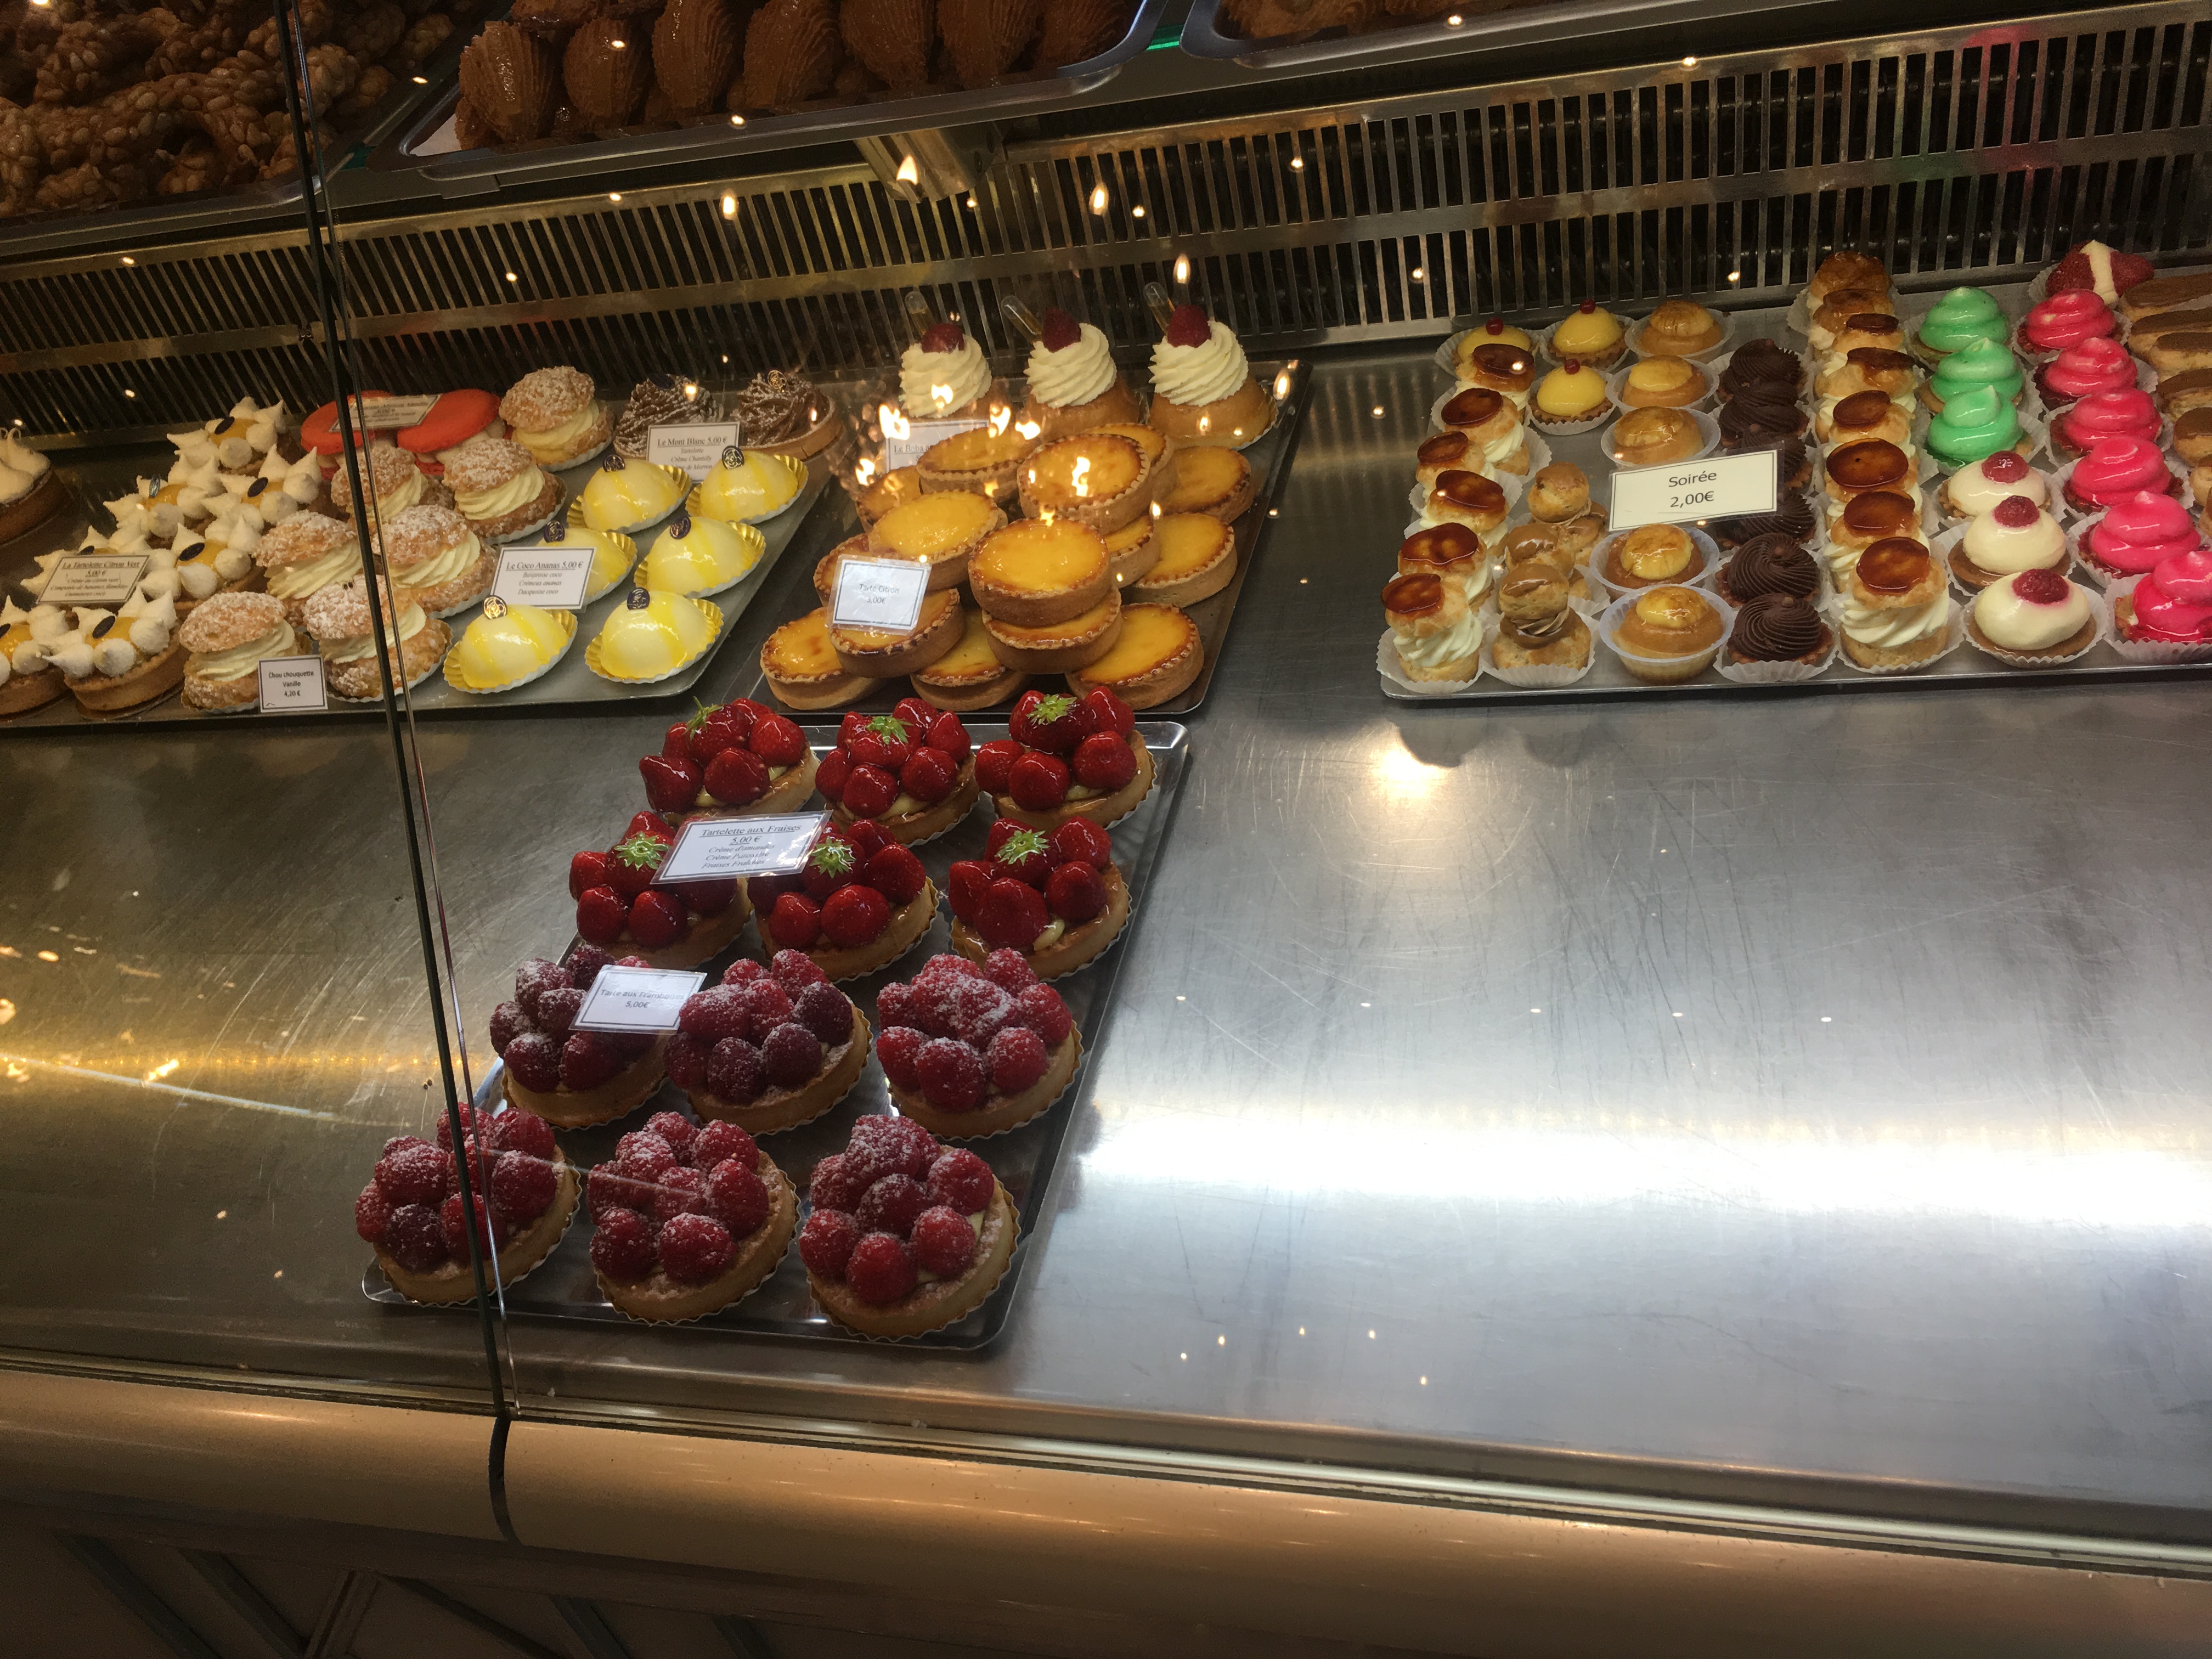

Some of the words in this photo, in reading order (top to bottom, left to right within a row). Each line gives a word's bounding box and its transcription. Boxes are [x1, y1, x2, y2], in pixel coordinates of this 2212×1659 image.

[707, 437, 721, 445] 5,00
[894, 445, 904, 453] Le
[905, 444, 924, 453] Baba
[1668, 471, 1717, 488] Soirée
[1670, 491, 1714, 508] 2,00€
[561, 561, 577, 570] 5,00
[878, 585, 899, 594] Citron
[701, 828, 746, 837] Tartelette
[767, 824, 802, 833] Fraises
[731, 836, 752, 844] 5,00
[735, 844, 776, 852] d'amandes
[639, 991, 685, 1000] Framboises
